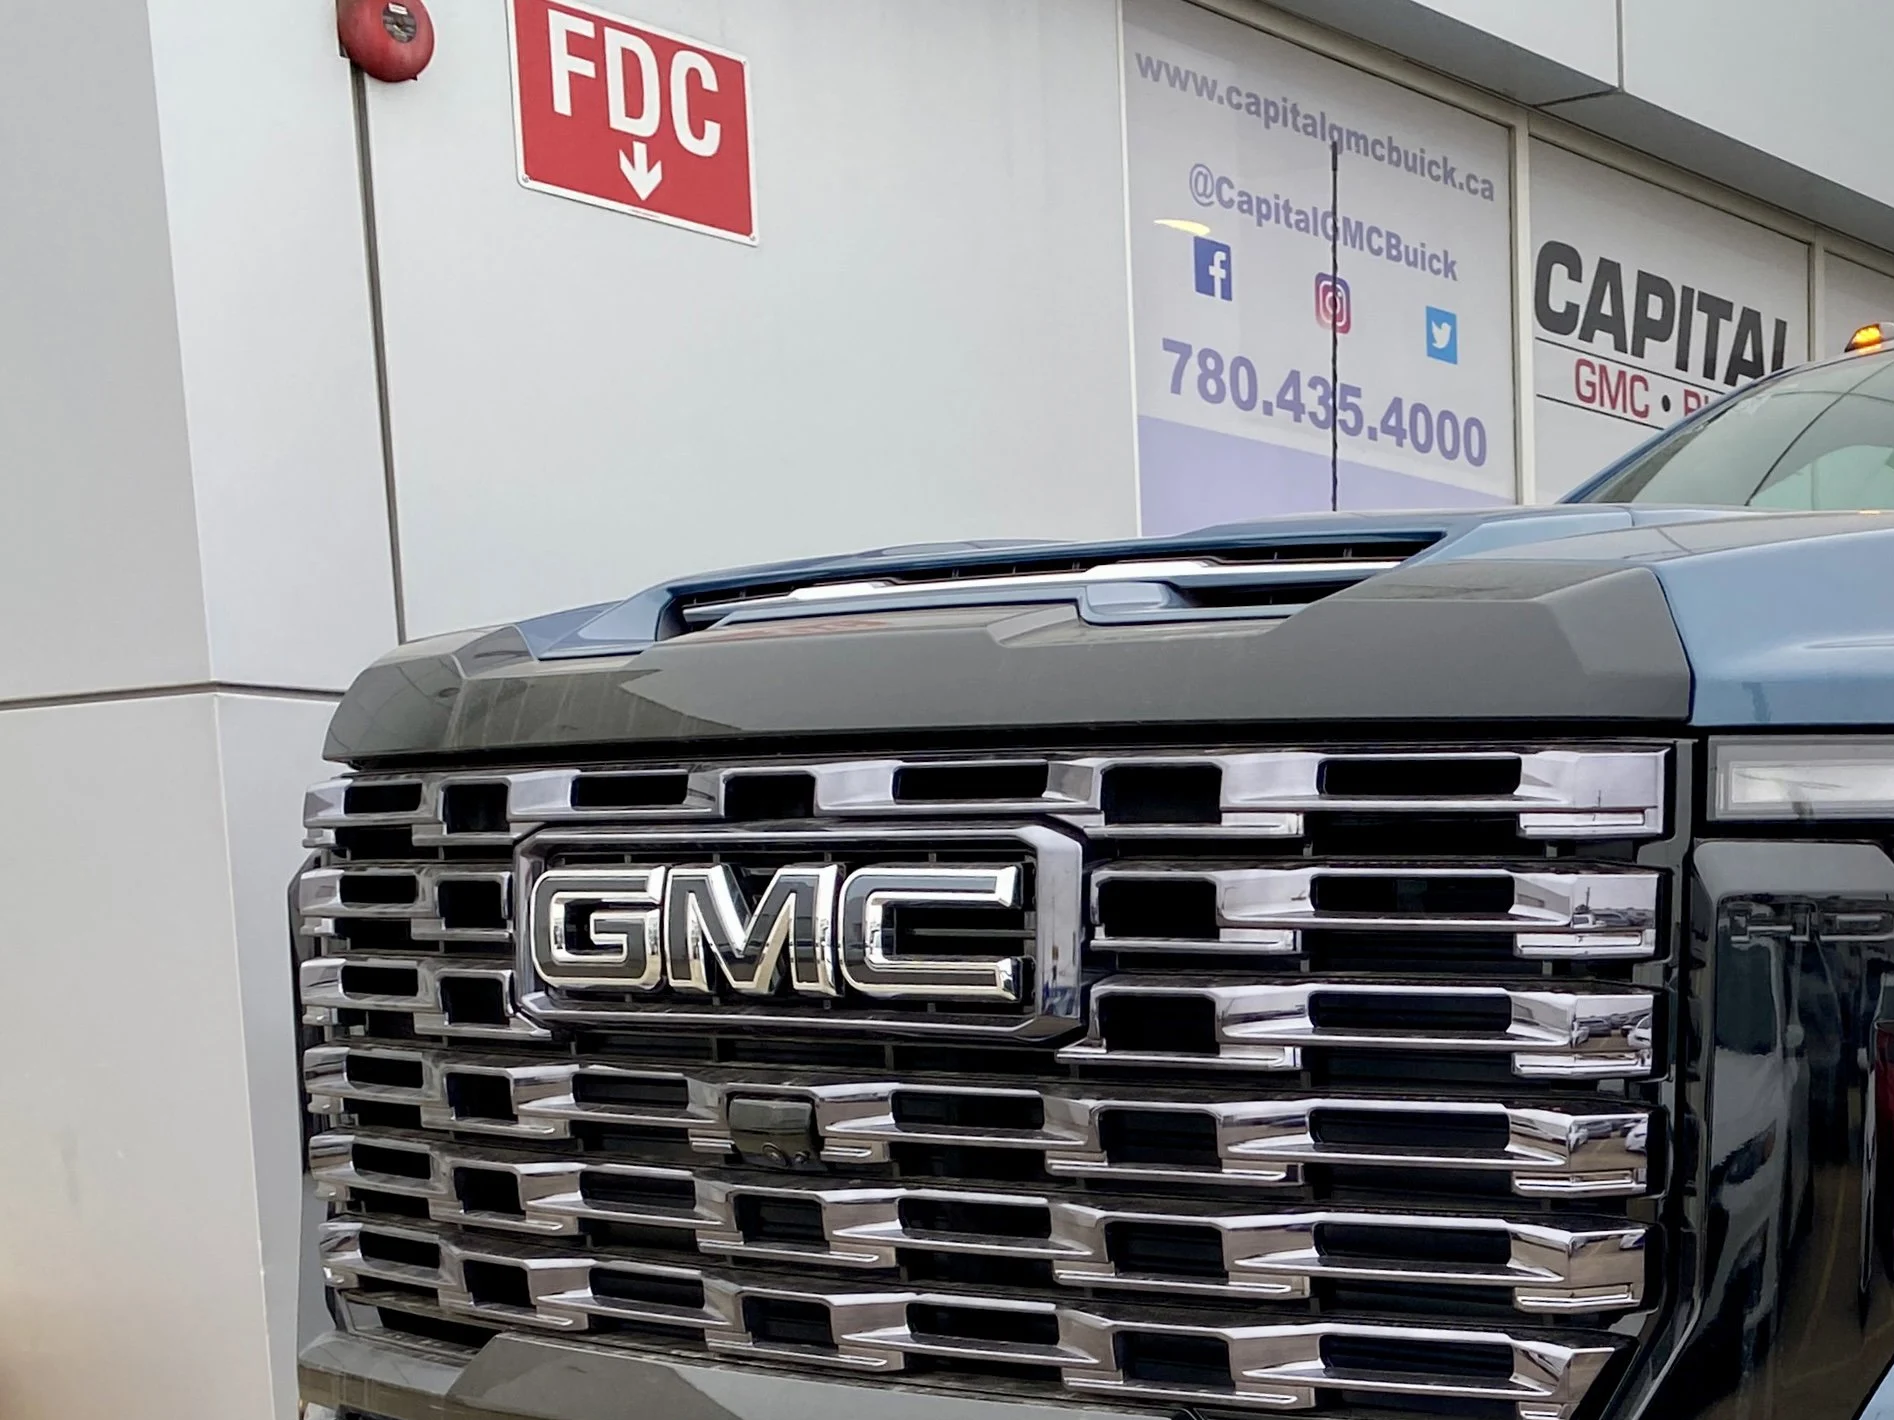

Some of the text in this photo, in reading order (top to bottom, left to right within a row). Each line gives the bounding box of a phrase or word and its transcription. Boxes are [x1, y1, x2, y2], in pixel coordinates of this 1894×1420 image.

[547, 8, 722, 157] FDC
[1136, 52, 1495, 201] www.capitalgmcbuick.ca
[1189, 163, 1458, 281] @CapitalGMCBuick
[1161, 337, 1487, 467] 780.435.4000
[1574, 358, 1649, 419] GMC
[531, 863, 1021, 1000] GMC
